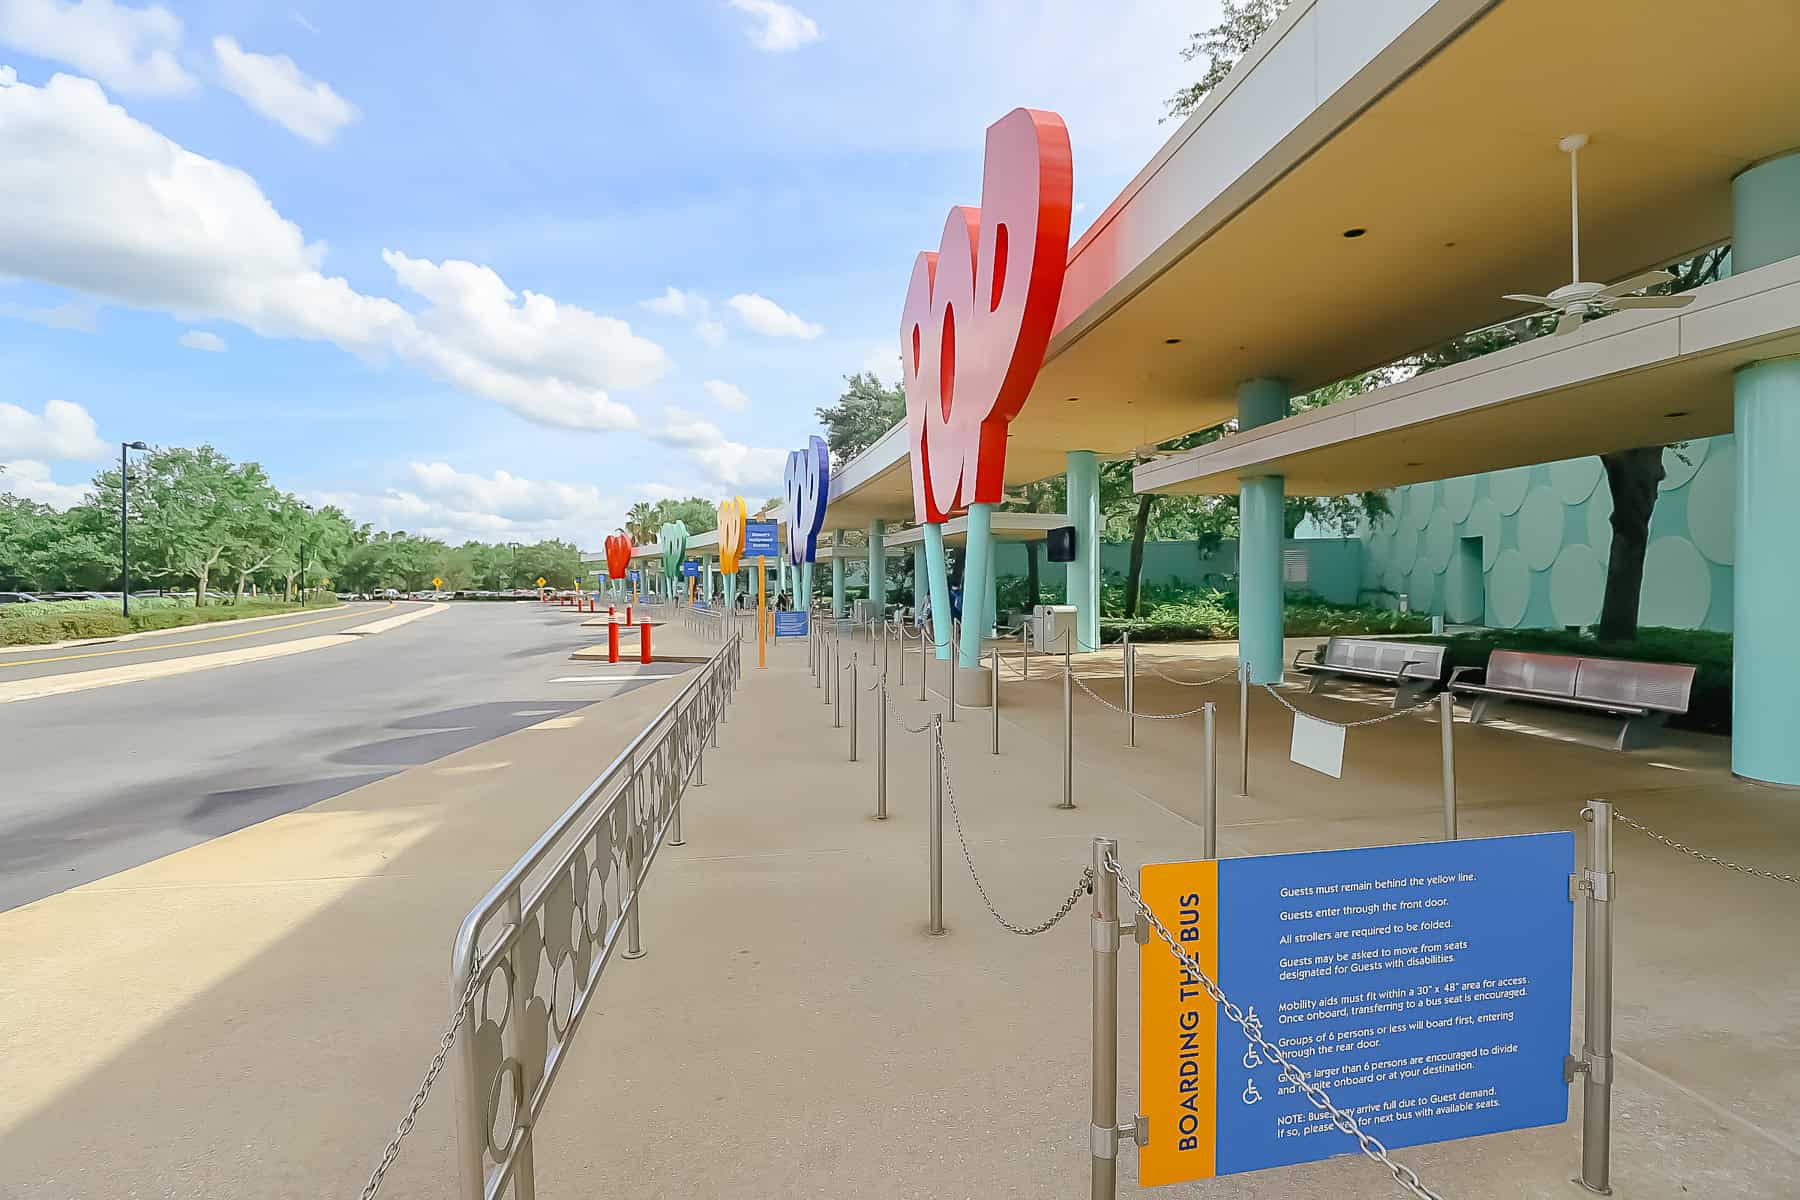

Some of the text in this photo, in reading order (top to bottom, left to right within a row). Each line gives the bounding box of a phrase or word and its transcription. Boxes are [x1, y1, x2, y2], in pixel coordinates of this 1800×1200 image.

[900, 107, 1073, 525] POP
[1280, 872, 1476, 897] Guests must remain behind the yellow line.
[1180, 893, 1200, 942] BUS
[1280, 898, 1448, 920] Guests enter through the front door.
[1280, 920, 1453, 944] All strollers are required to be folded.
[1280, 941, 1468, 967] Guests may be asked to move from seats
[1280, 966, 1331, 980] designated
[1334, 965, 1348, 973] for
[1350, 962, 1382, 972] Guests
[1385, 959, 1404, 968] with
[1279, 999, 1316, 1012] Mobility
[1319, 996, 1338, 1007] aids
[1341, 994, 1364, 1004] must
[1366, 992, 1376, 1001] fit
[1379, 988, 1406, 999] within
[1434, 986, 1440, 994] x
[1462, 981, 1480, 990] area
[1483, 979, 1496, 988] for
[1497, 976, 1530, 987] access.
[1279, 987, 1528, 1023] Once onboard, transferring to a bus seat is encouraged.
[1279, 1011, 1514, 1047] Groups of 6 persons or less will board first, entering
[1318, 1045, 1334, 1054] the
[1335, 1043, 1354, 1052] rear
[1357, 1039, 1381, 1049] door.
[1314, 1067, 1340, 1078] larger
[1342, 1064, 1361, 1074] than
[1364, 1062, 1370, 1071] 6
[1371, 1058, 1407, 1071] persons
[1409, 1056, 1423, 1065] are
[1426, 1048, 1478, 1063] encouraged
[1479, 1047, 1489, 1056] to
[1491, 1043, 1518, 1055] divide
[1178, 1010, 1199, 1152] BOARDING
[1278, 1085, 1296, 1095] and
[1334, 1074, 1373, 1086] onboard
[1376, 1072, 1386, 1081] or
[1388, 1070, 1397, 1080] at
[1400, 1069, 1420, 1080] your
[1277, 1129, 1285, 1138] If
[1287, 1129, 1301, 1137] so,
[1303, 1123, 1334, 1136] please
[1358, 1117, 1370, 1127] for
[1374, 1114, 1394, 1124] next
[1396, 1112, 1413, 1121] bus
[1415, 1108, 1434, 1118] with
[1436, 1102, 1474, 1115] available
[1475, 1099, 1501, 1110] seats.
[1278, 1113, 1305, 1125] NOTE:
[1356, 1103, 1381, 1114] arrive
[1383, 1101, 1396, 1111] full
[1398, 1098, 1416, 1108] due
[1418, 1096, 1428, 1105] to
[1430, 1093, 1456, 1104] Guest
[1459, 1087, 1497, 1099] demand.
